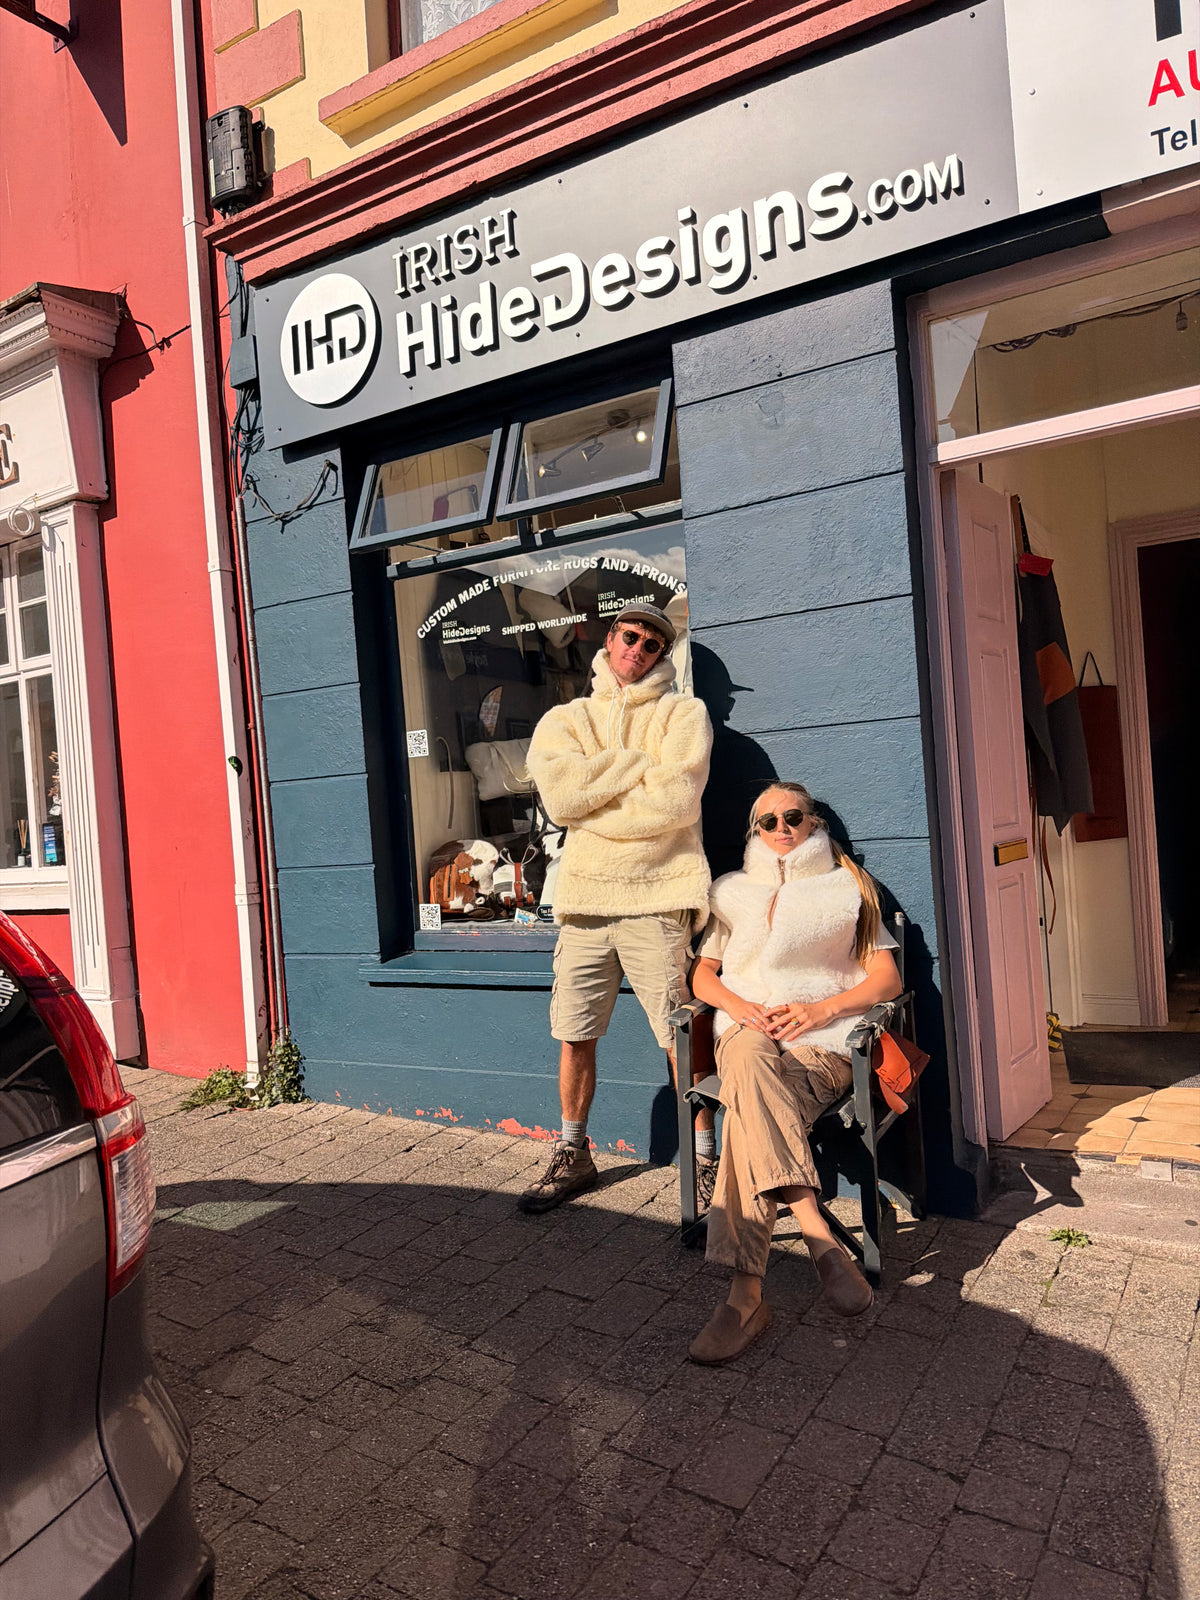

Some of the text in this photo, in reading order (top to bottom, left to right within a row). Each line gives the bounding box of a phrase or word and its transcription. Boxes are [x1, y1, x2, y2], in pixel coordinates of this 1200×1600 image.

[391, 208, 520, 298] IRISH
[417, 598, 458, 639] CUSTOM
[457, 579, 492, 605] MADE
[564, 556, 598, 570] RUGS
[601, 557, 629, 572] AND
[631, 562, 686, 595] APRONS
[597, 590, 616, 601] IRISH
[442, 625, 491, 639] HideDesigns
[501, 622, 536, 636] SHIPPED
[537, 613, 588, 630] WORLDWIDE
